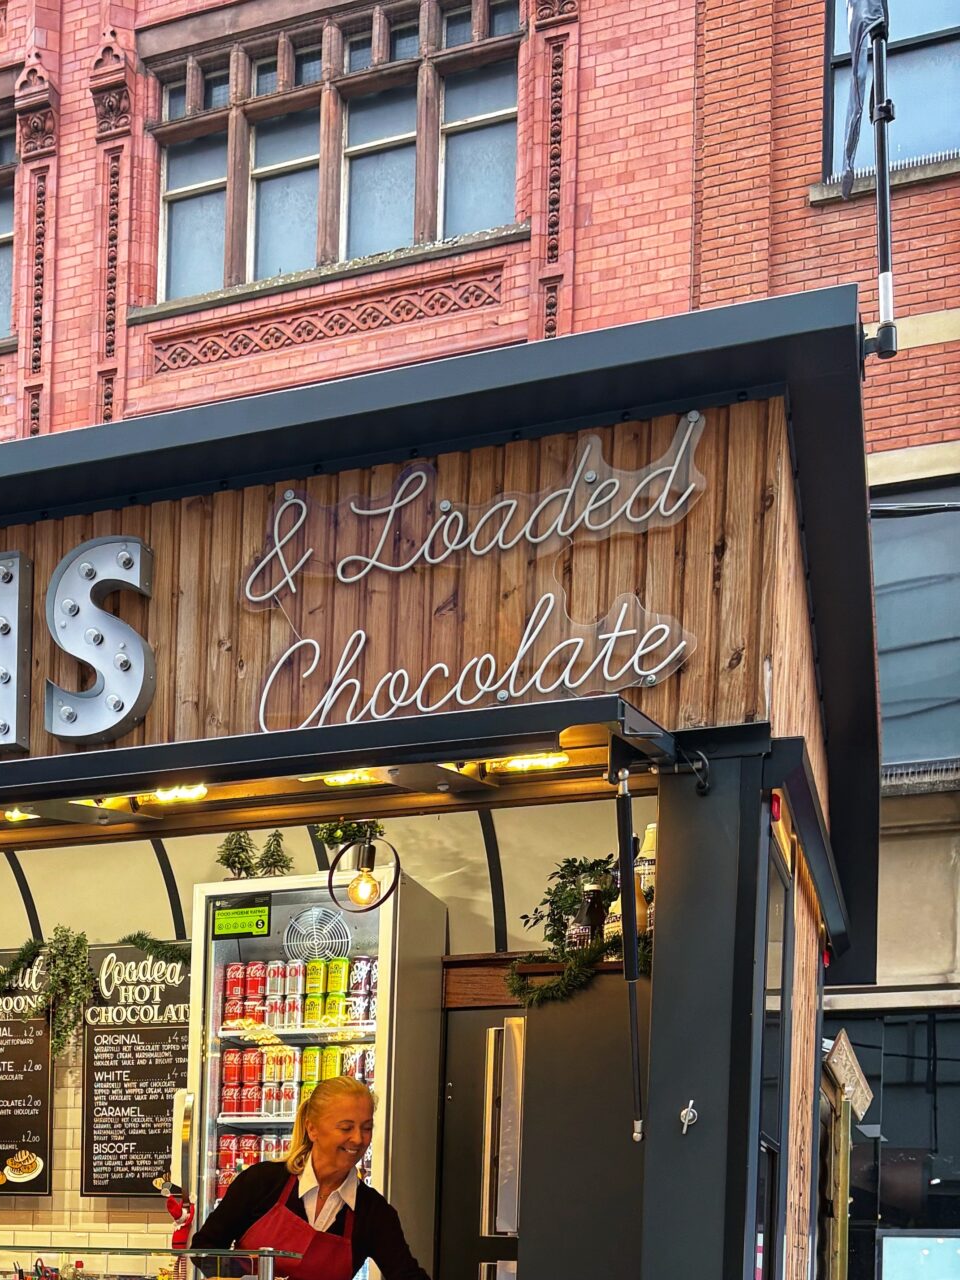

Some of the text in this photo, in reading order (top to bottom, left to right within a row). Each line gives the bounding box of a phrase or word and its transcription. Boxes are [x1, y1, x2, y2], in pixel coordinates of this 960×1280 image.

[245, 419, 697, 602] & Loaded
[259, 592, 687, 732] Chocolate
[118, 984, 166, 1005] HOT
[94, 1034, 144, 1045] ORIGINAL
[94, 1071, 131, 1081] WHITE
[94, 1107, 144, 1117] CARAMEL
[93, 1143, 136, 1154] BISCOFF
